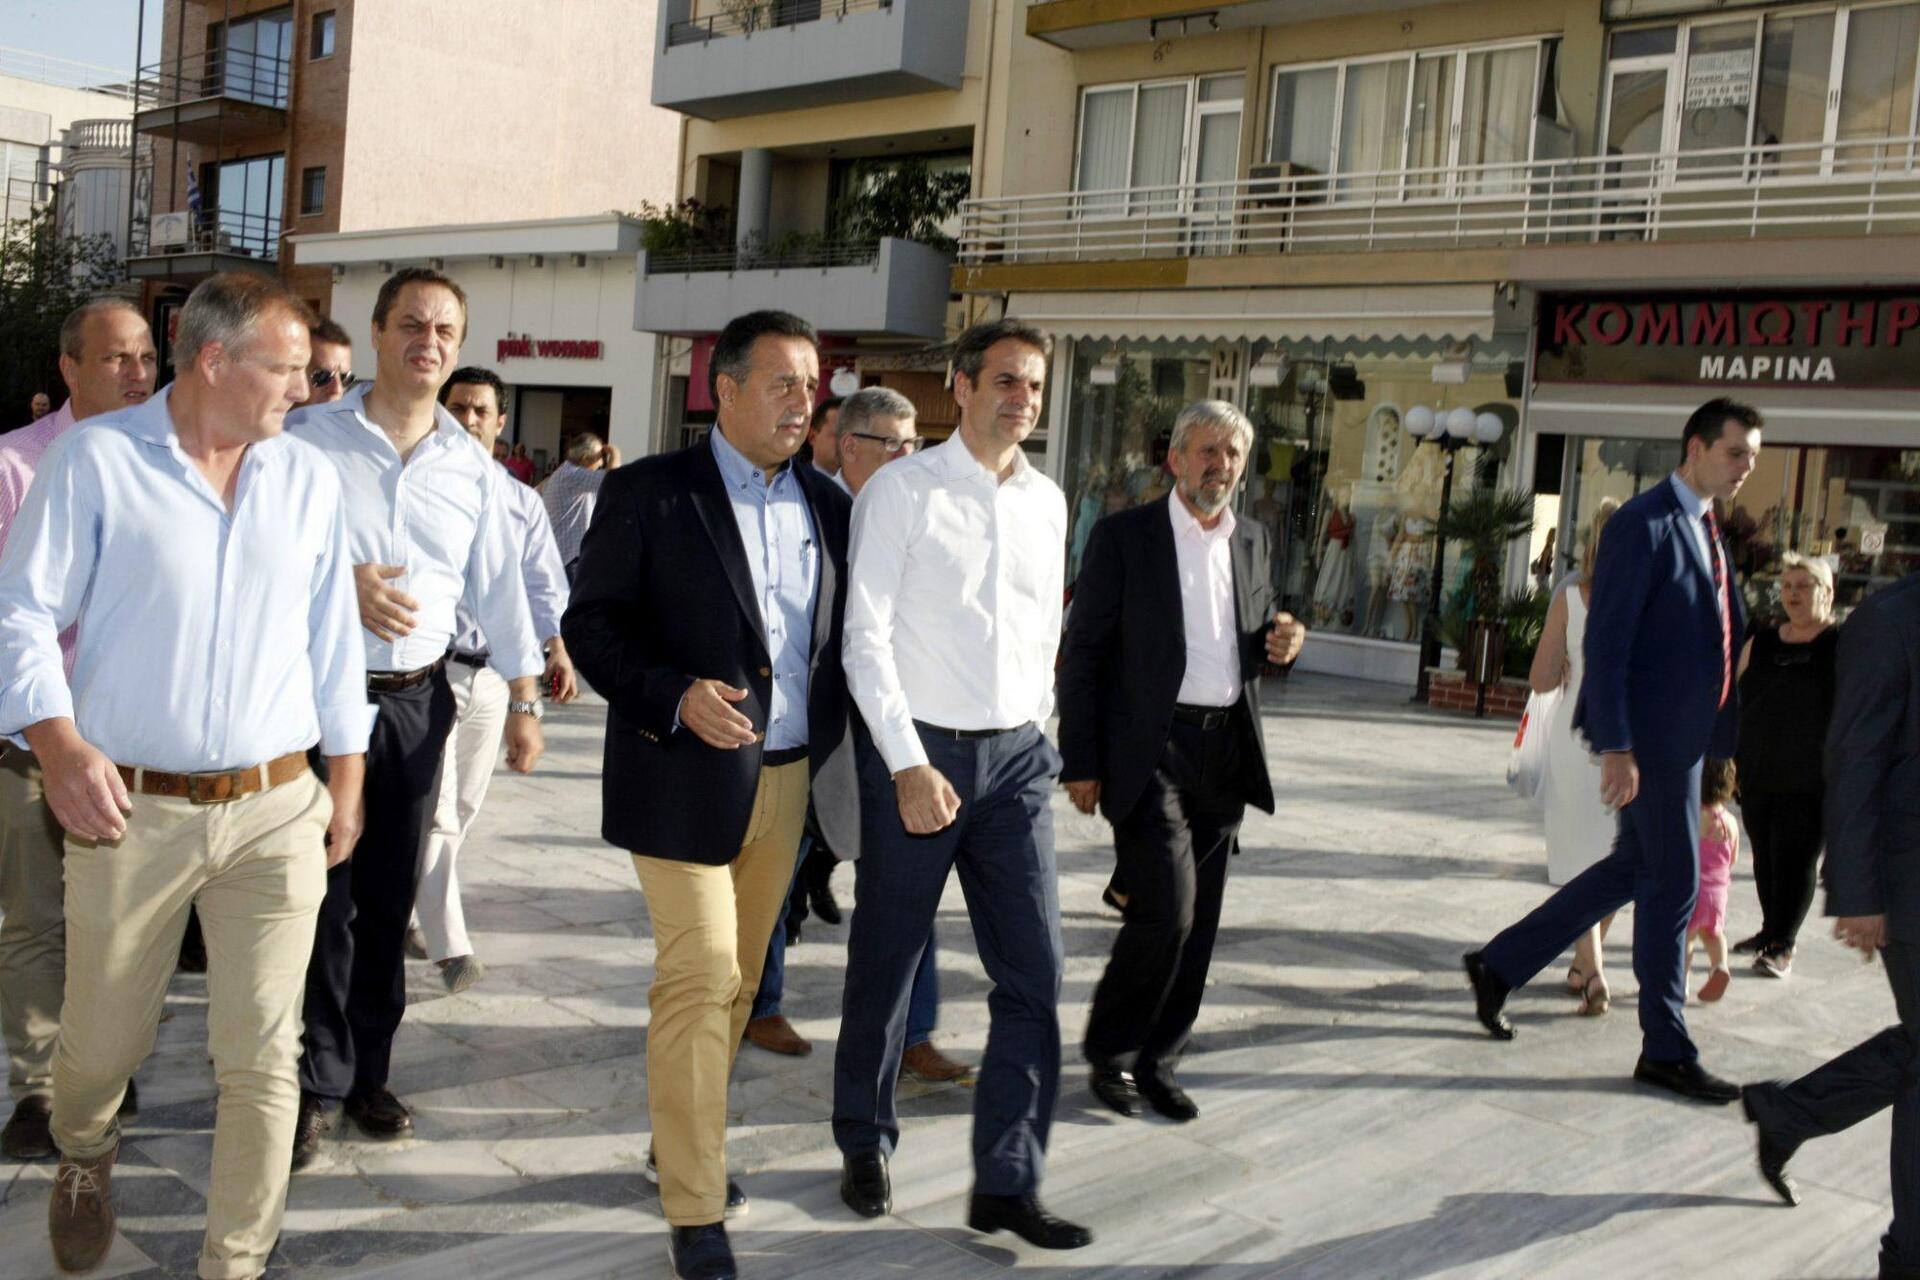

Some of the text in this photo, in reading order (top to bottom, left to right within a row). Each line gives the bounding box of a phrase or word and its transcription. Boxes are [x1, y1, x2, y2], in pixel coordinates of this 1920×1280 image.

[1554, 302, 1920, 346] ΚΟΜΜΩΤΗΡ
[497, 331, 602, 363] pink woman
[1700, 355, 1836, 381] ΜΑΡΙΝΑ
